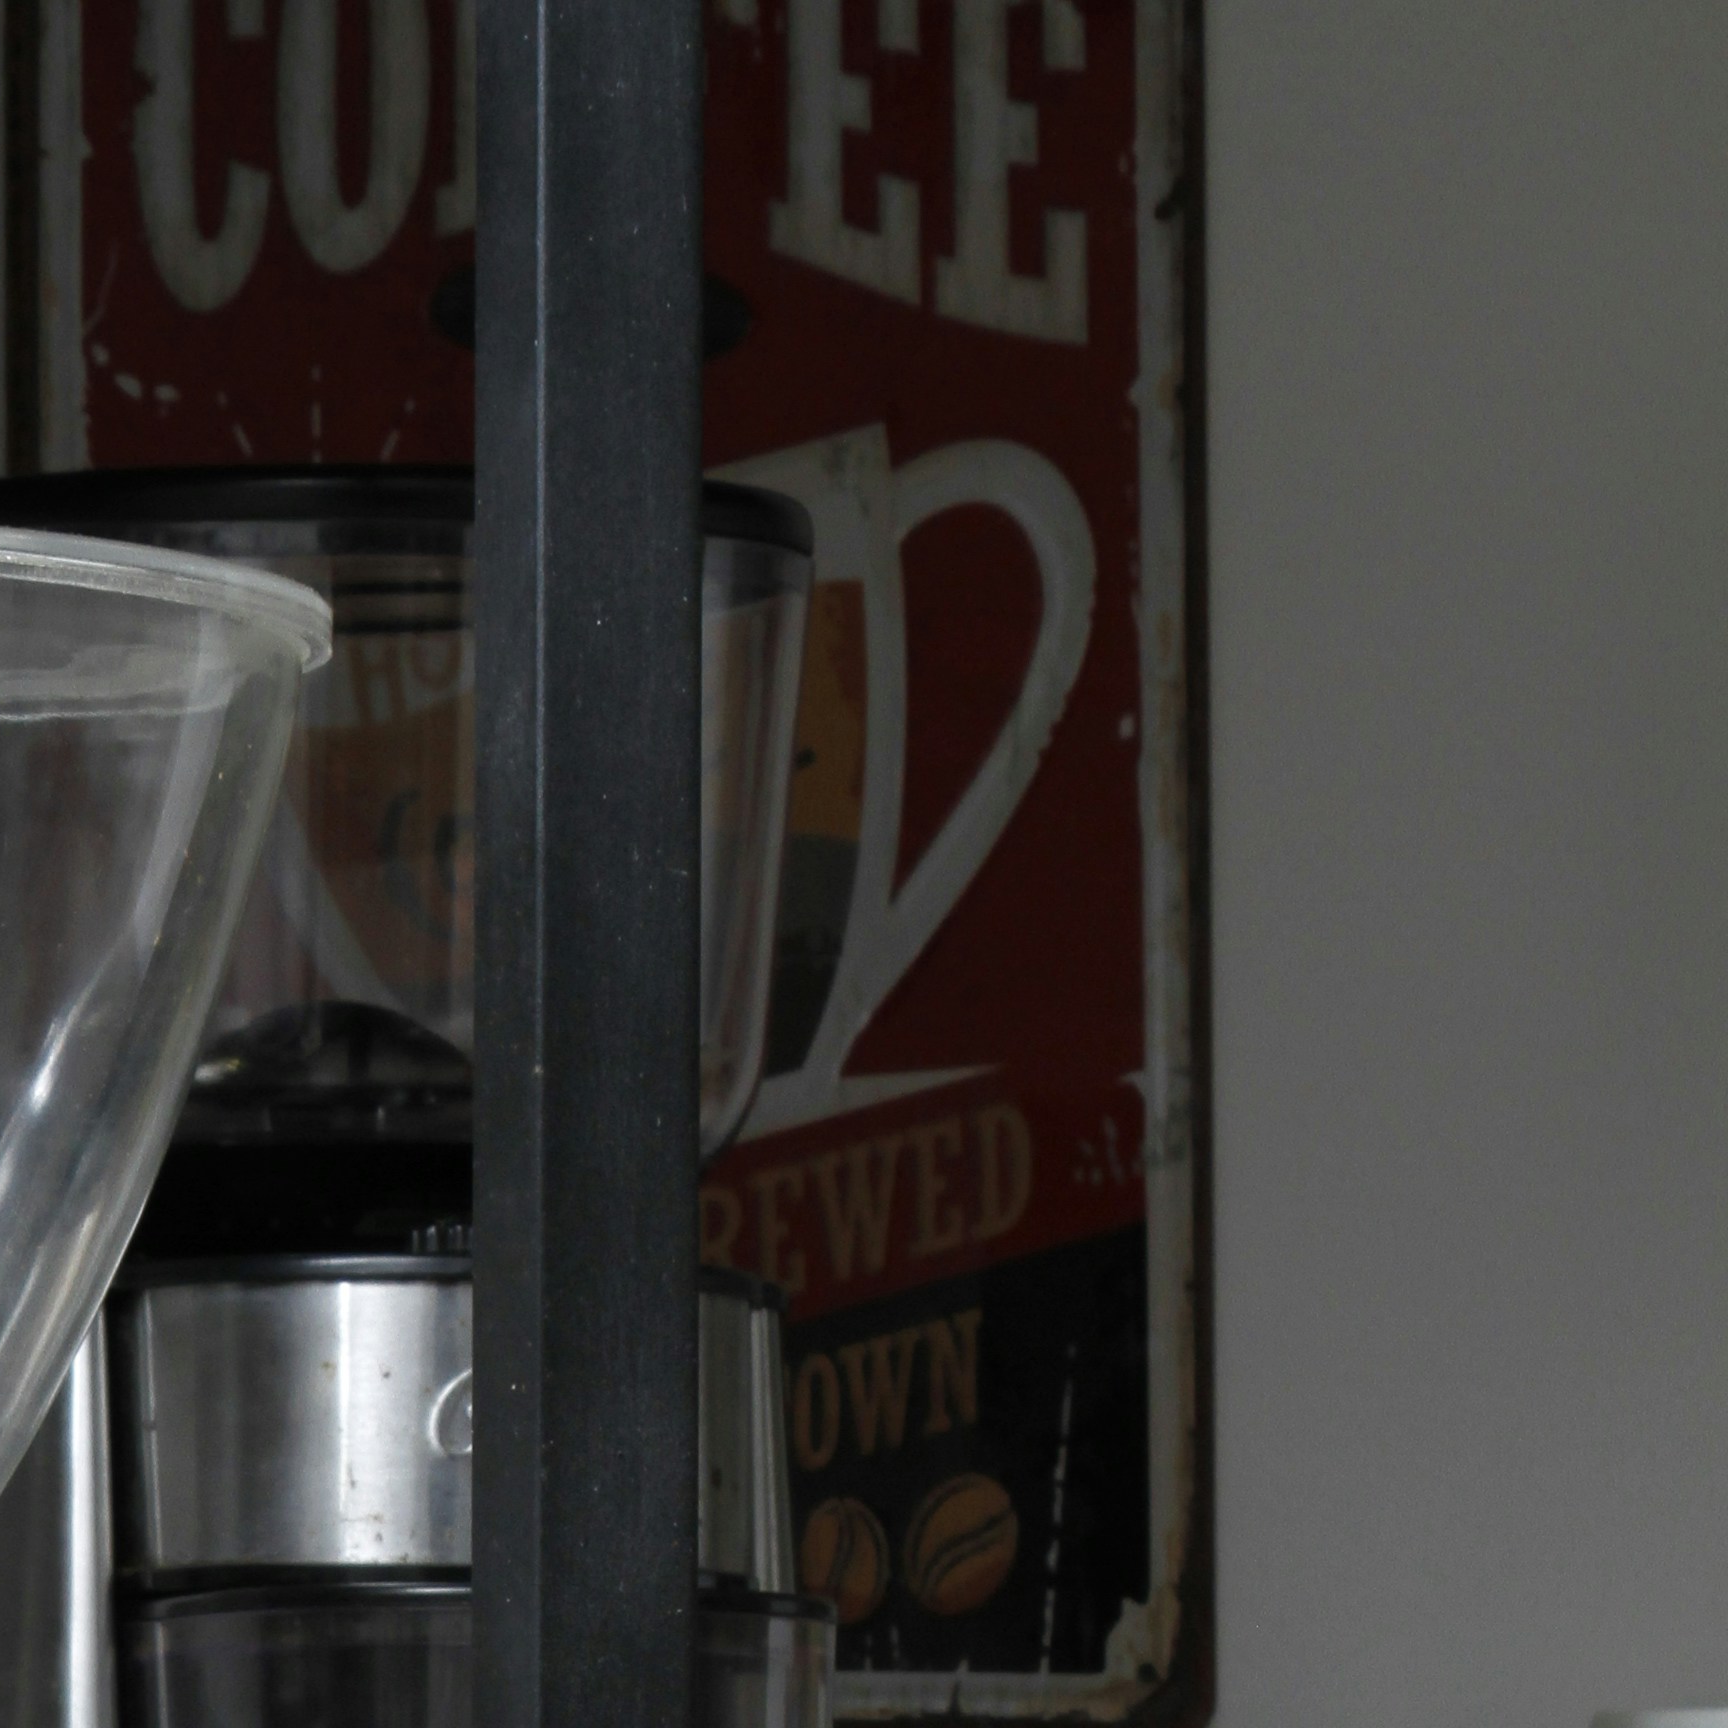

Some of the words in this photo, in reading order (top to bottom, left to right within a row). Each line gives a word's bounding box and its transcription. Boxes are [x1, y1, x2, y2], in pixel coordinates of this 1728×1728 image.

[133, 0, 1089, 346] COEE
[699, 1102, 1033, 1298] REWED
[790, 1308, 983, 1471] OWN
